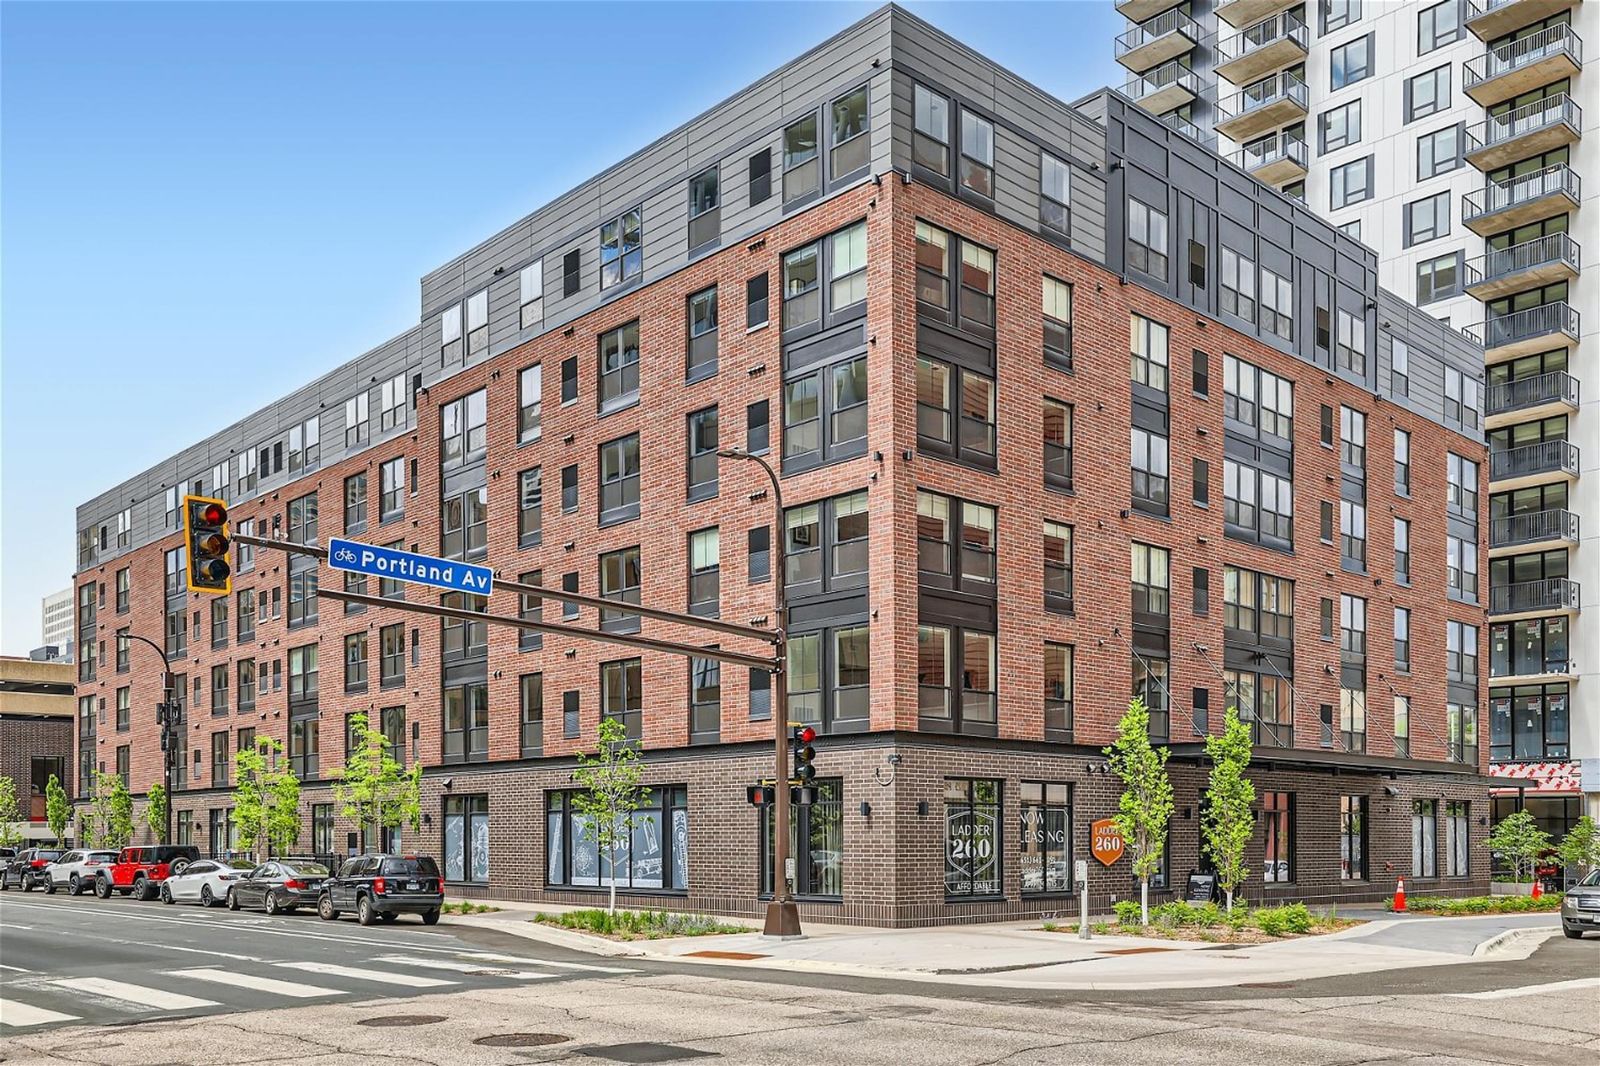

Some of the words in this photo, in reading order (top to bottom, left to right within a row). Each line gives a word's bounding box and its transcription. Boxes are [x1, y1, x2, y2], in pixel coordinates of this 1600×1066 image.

[361, 550, 452, 583] Portland
[462, 570, 487, 589] Av
[1020, 812, 1044, 825] NOW
[952, 824, 990, 836] LADDER
[1020, 829, 1064, 844] EASNG
[952, 838, 991, 859] 260
[1095, 836, 1120, 852] 260
